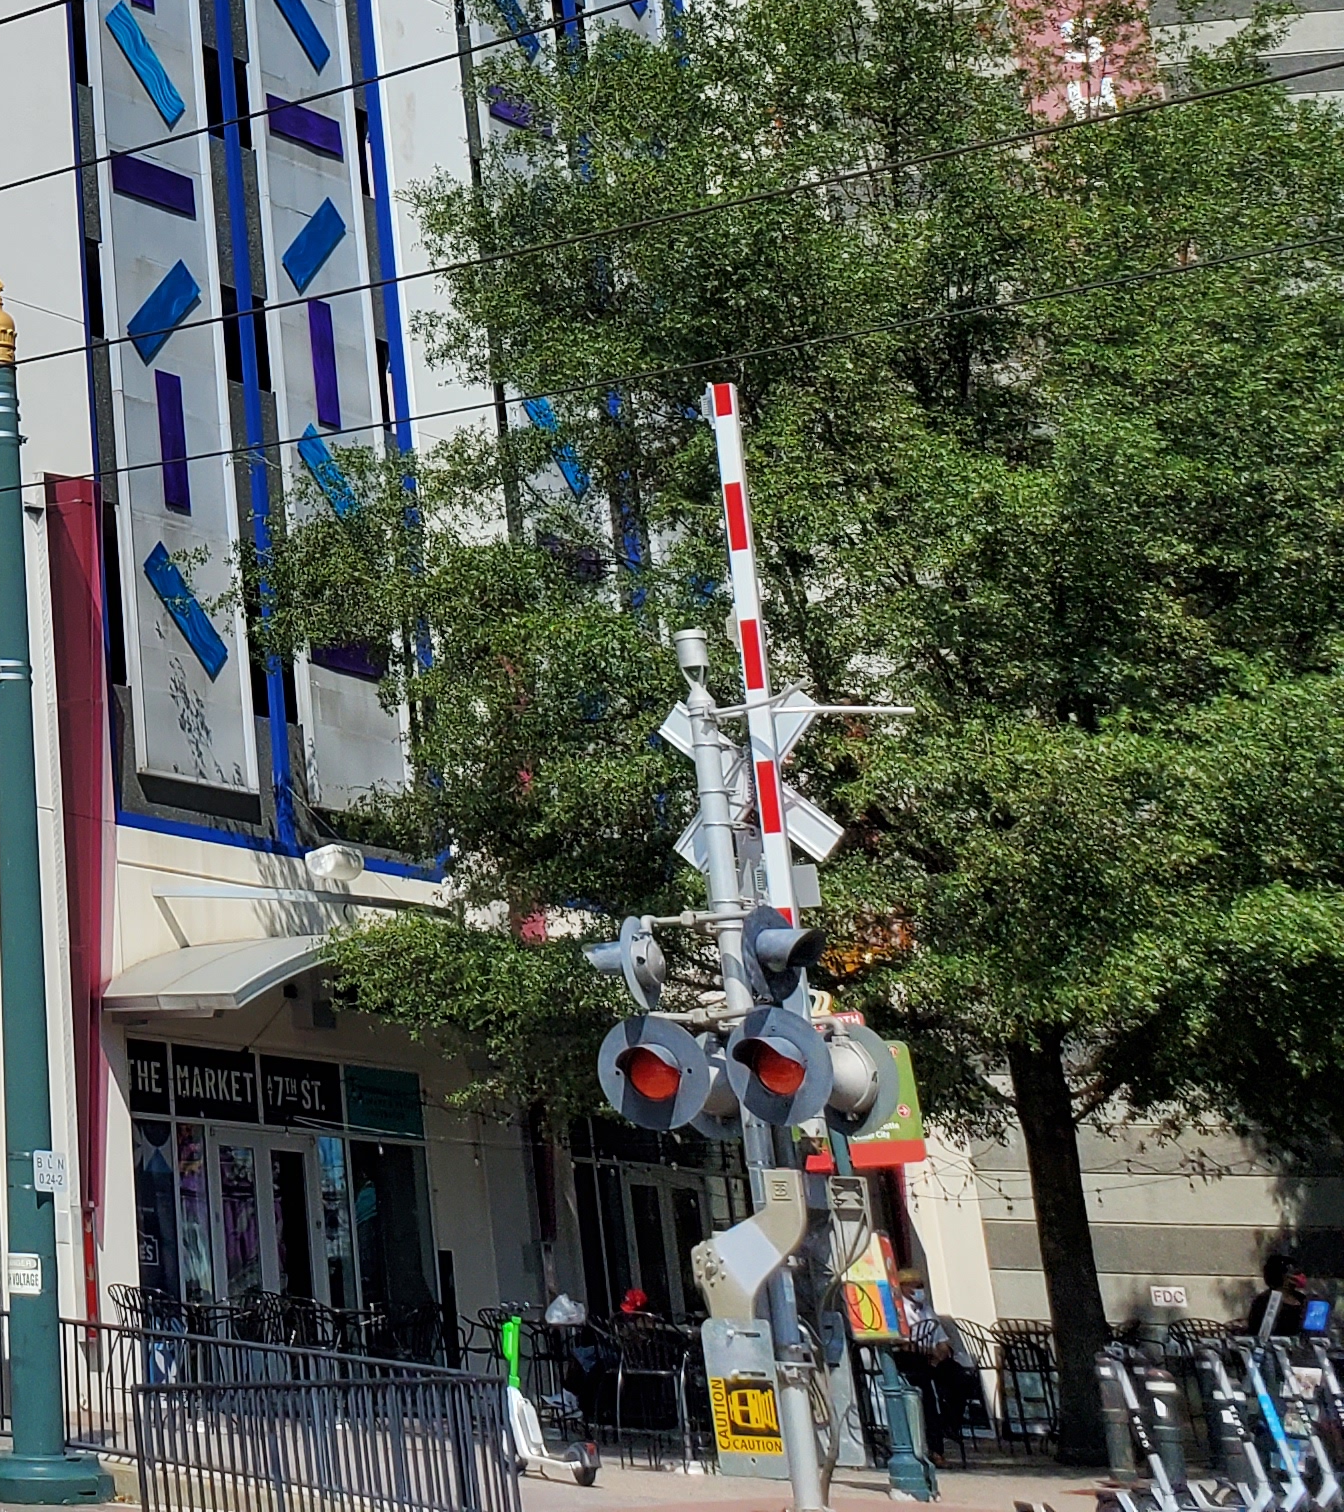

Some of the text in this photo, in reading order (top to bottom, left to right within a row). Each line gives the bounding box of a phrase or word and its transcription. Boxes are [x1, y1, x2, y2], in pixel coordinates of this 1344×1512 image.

[129, 1058, 163, 1094] THE
[176, 1064, 254, 1104] MARKET
[273, 1076, 298, 1106] 7TH
[301, 1079, 326, 1111] ST.
[39, 1173, 63, 1186] 0.24-2
[12, 1272, 39, 1287] VOLTAGE
[1153, 1290, 1184, 1303] FDC
[711, 1379, 731, 1450] CAUTION
[733, 1439, 783, 1453] CAUTION
